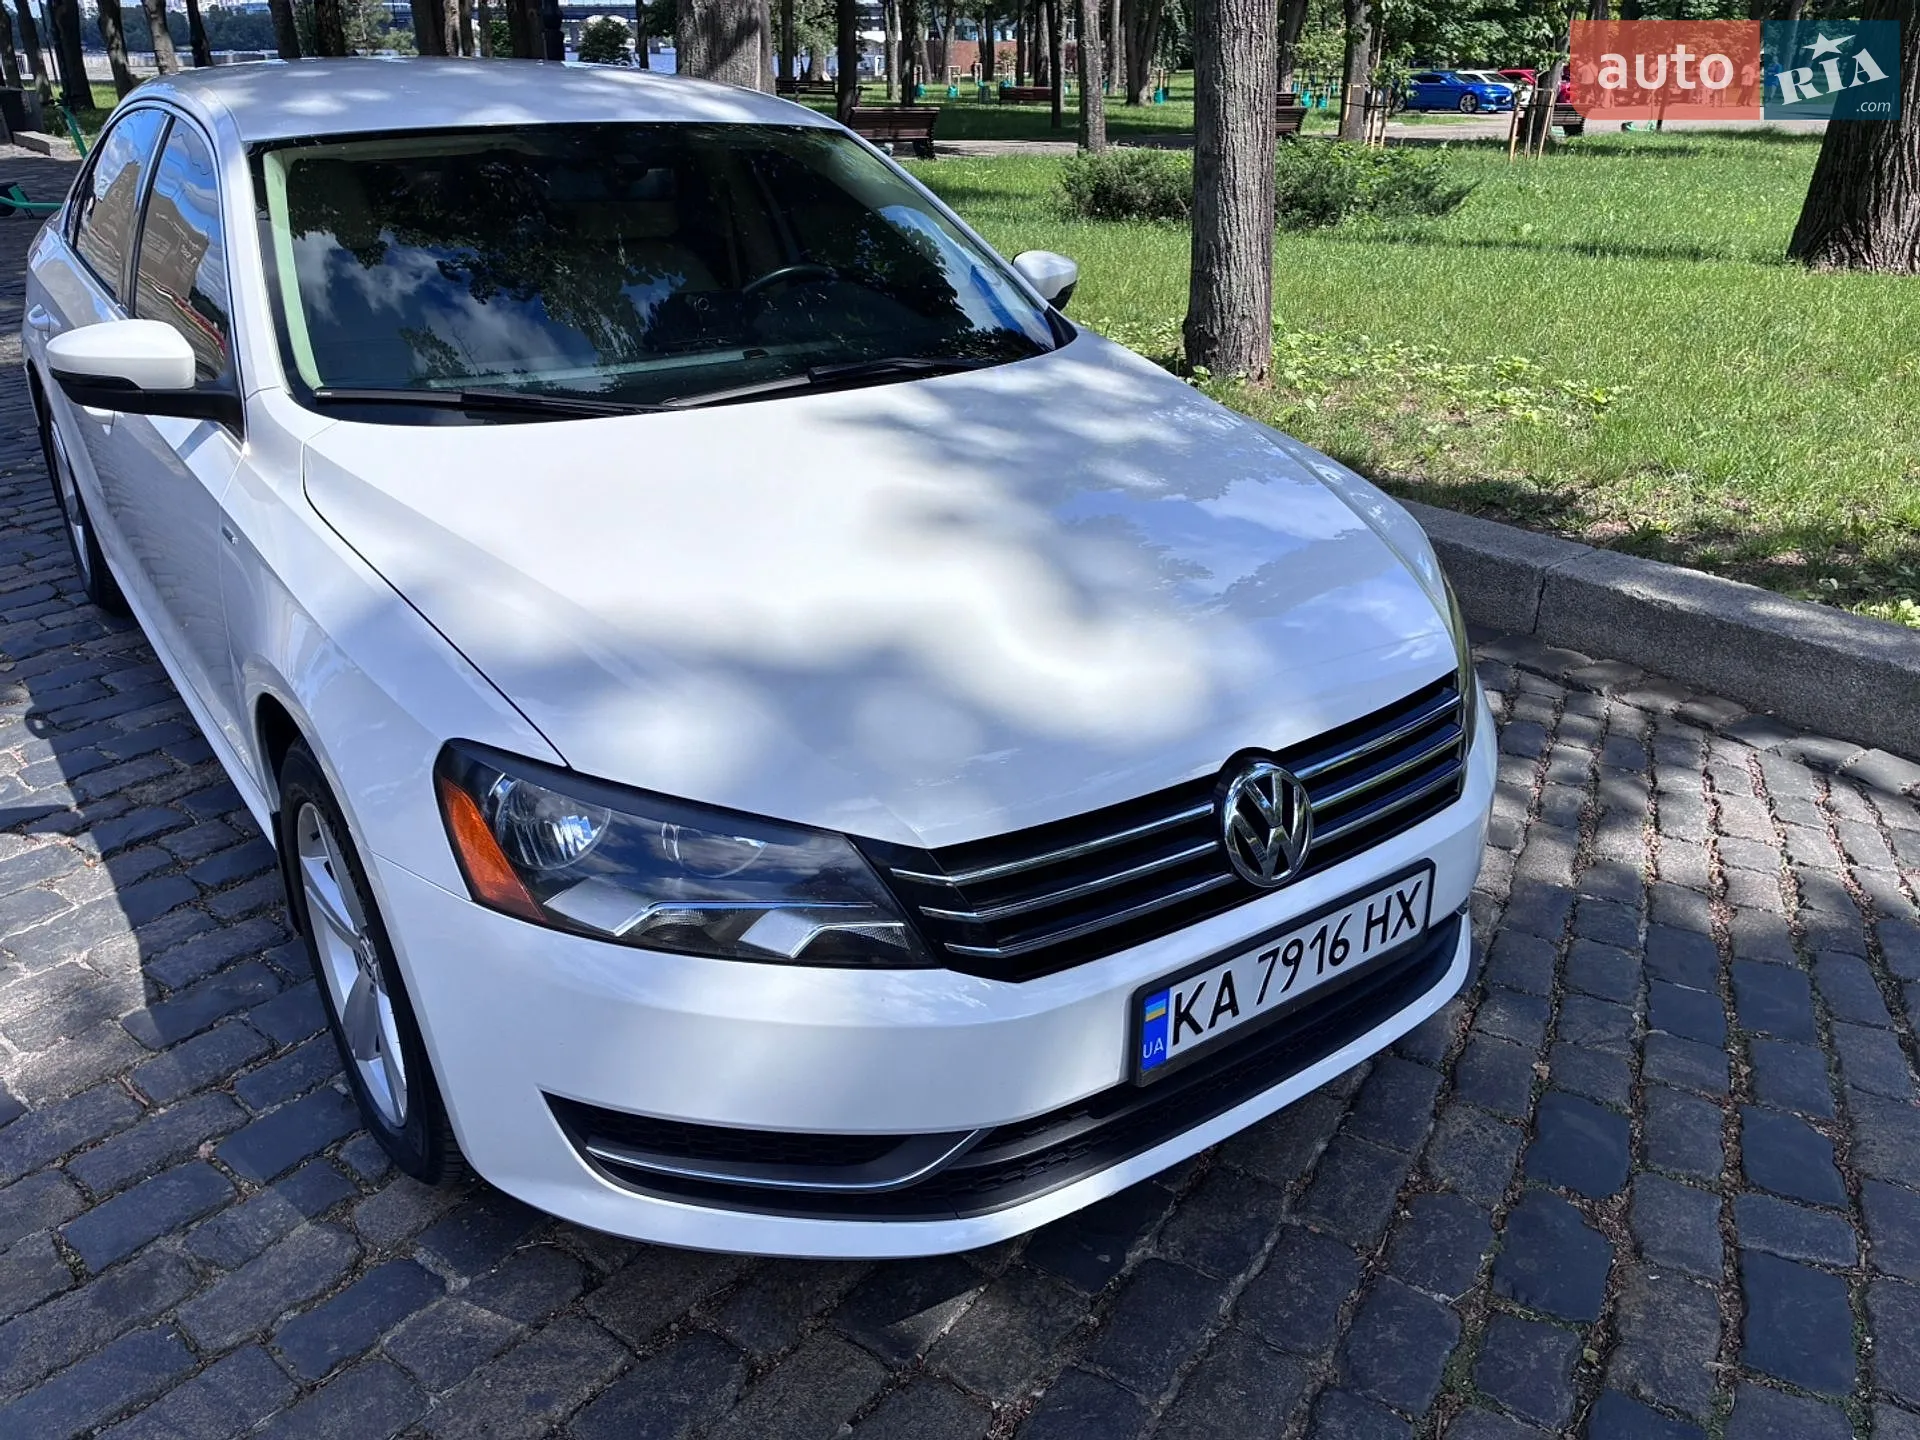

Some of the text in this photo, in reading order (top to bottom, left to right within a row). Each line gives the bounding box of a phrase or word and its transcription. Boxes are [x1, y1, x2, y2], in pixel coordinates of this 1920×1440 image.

[1172, 881, 1422, 1047] KA 7916 HX
[1143, 1037, 1164, 1059] UA
